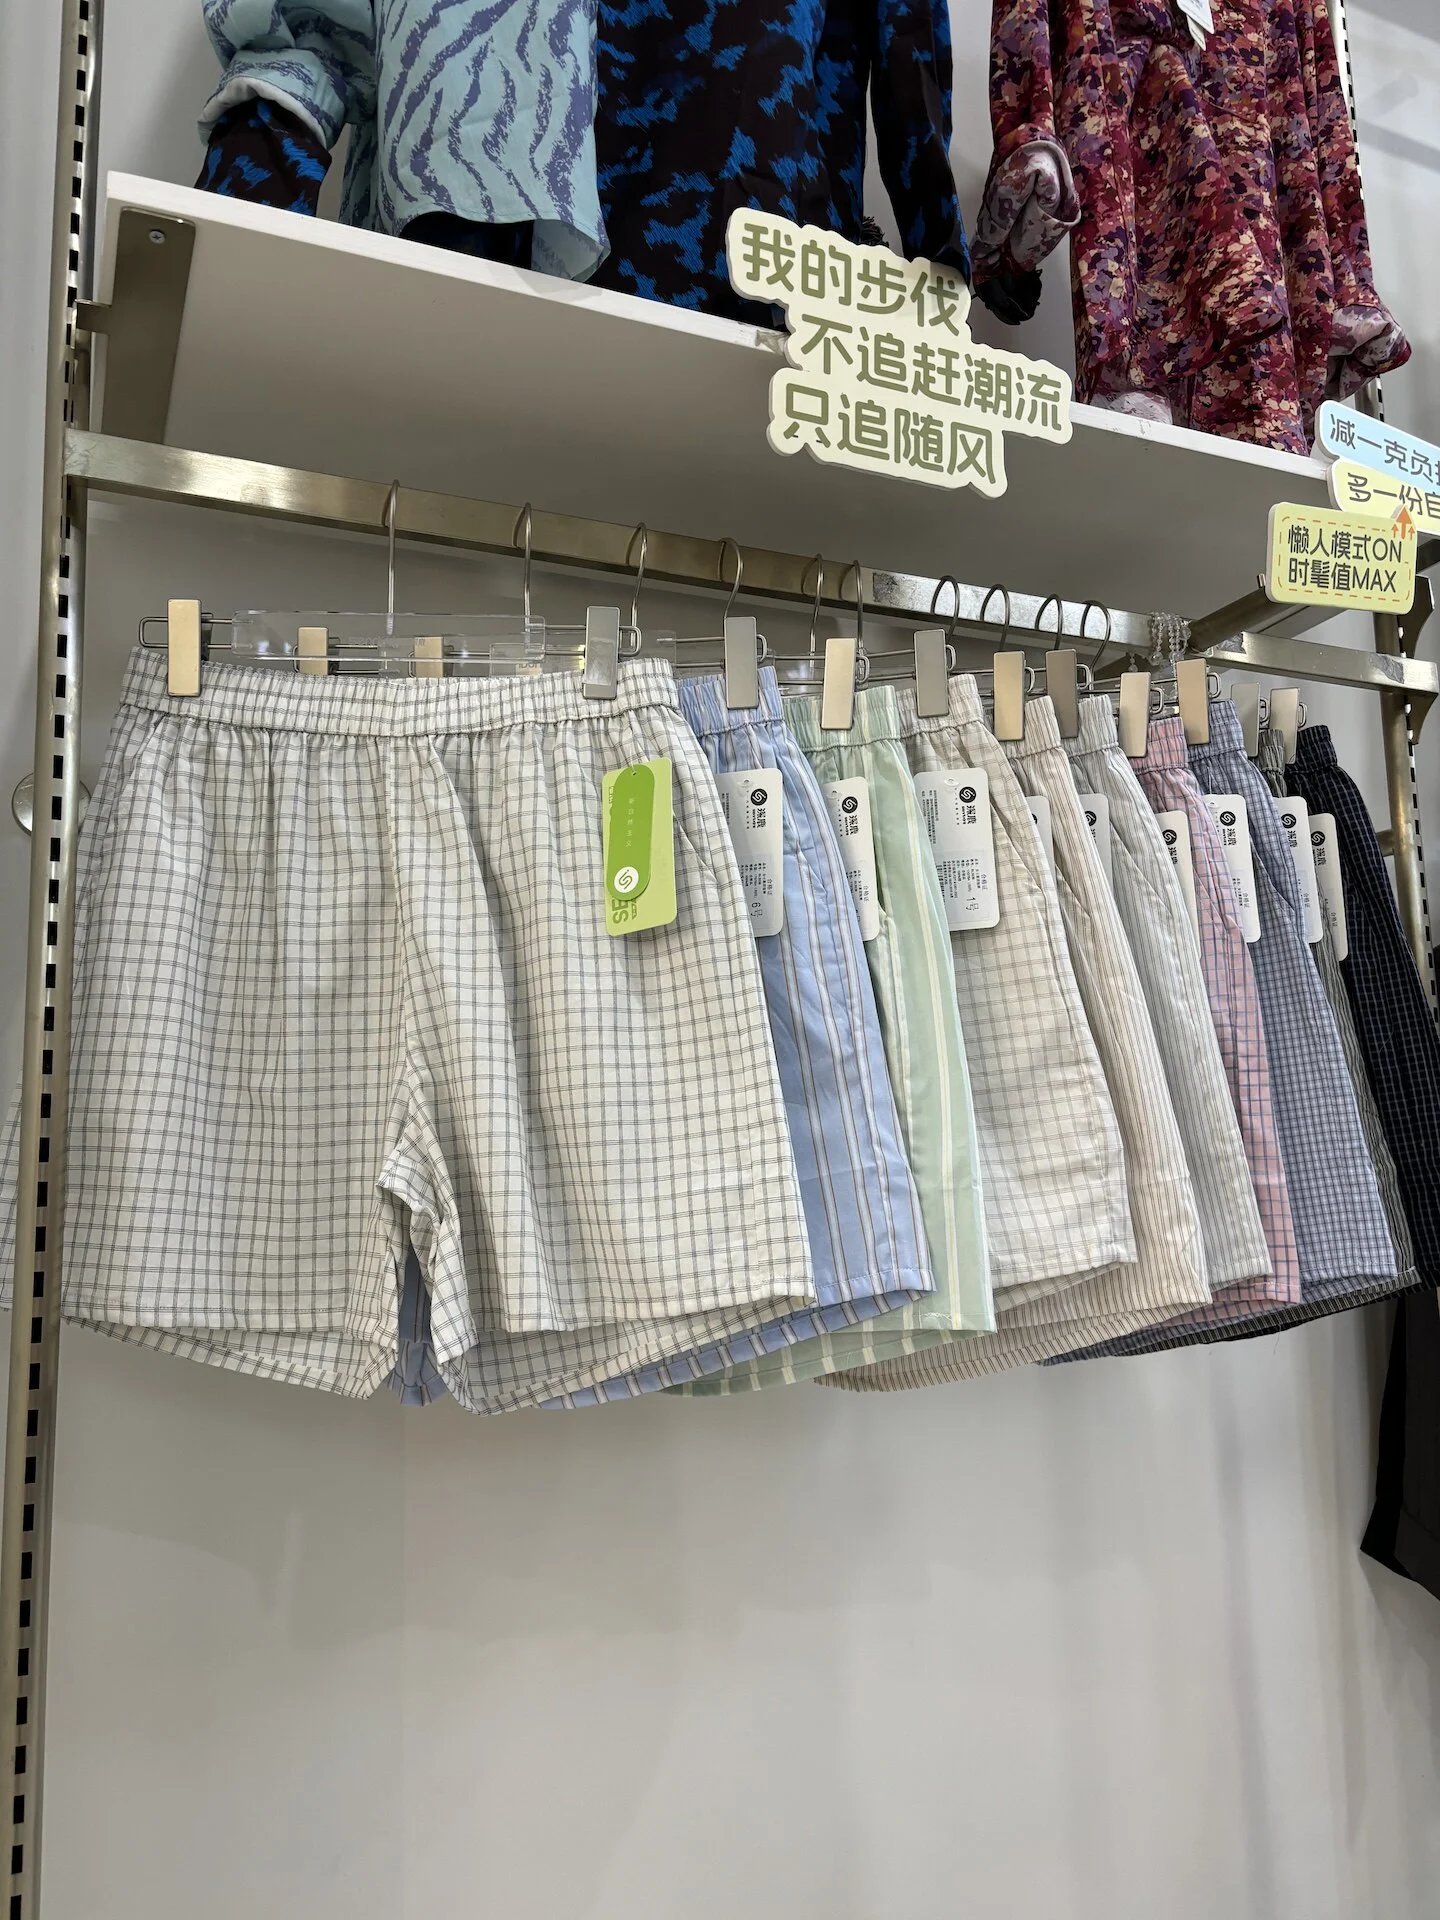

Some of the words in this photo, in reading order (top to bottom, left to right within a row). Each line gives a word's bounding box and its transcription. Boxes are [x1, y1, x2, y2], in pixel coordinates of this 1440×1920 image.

[741, 222, 960, 336] 我的步伐
[800, 313, 1063, 432] 不追赶潮流
[783, 382, 997, 485] 只追随风
[1287, 524, 1402, 564] 懒人模式ON
[1288, 557, 1397, 594] 时髦值MAX
